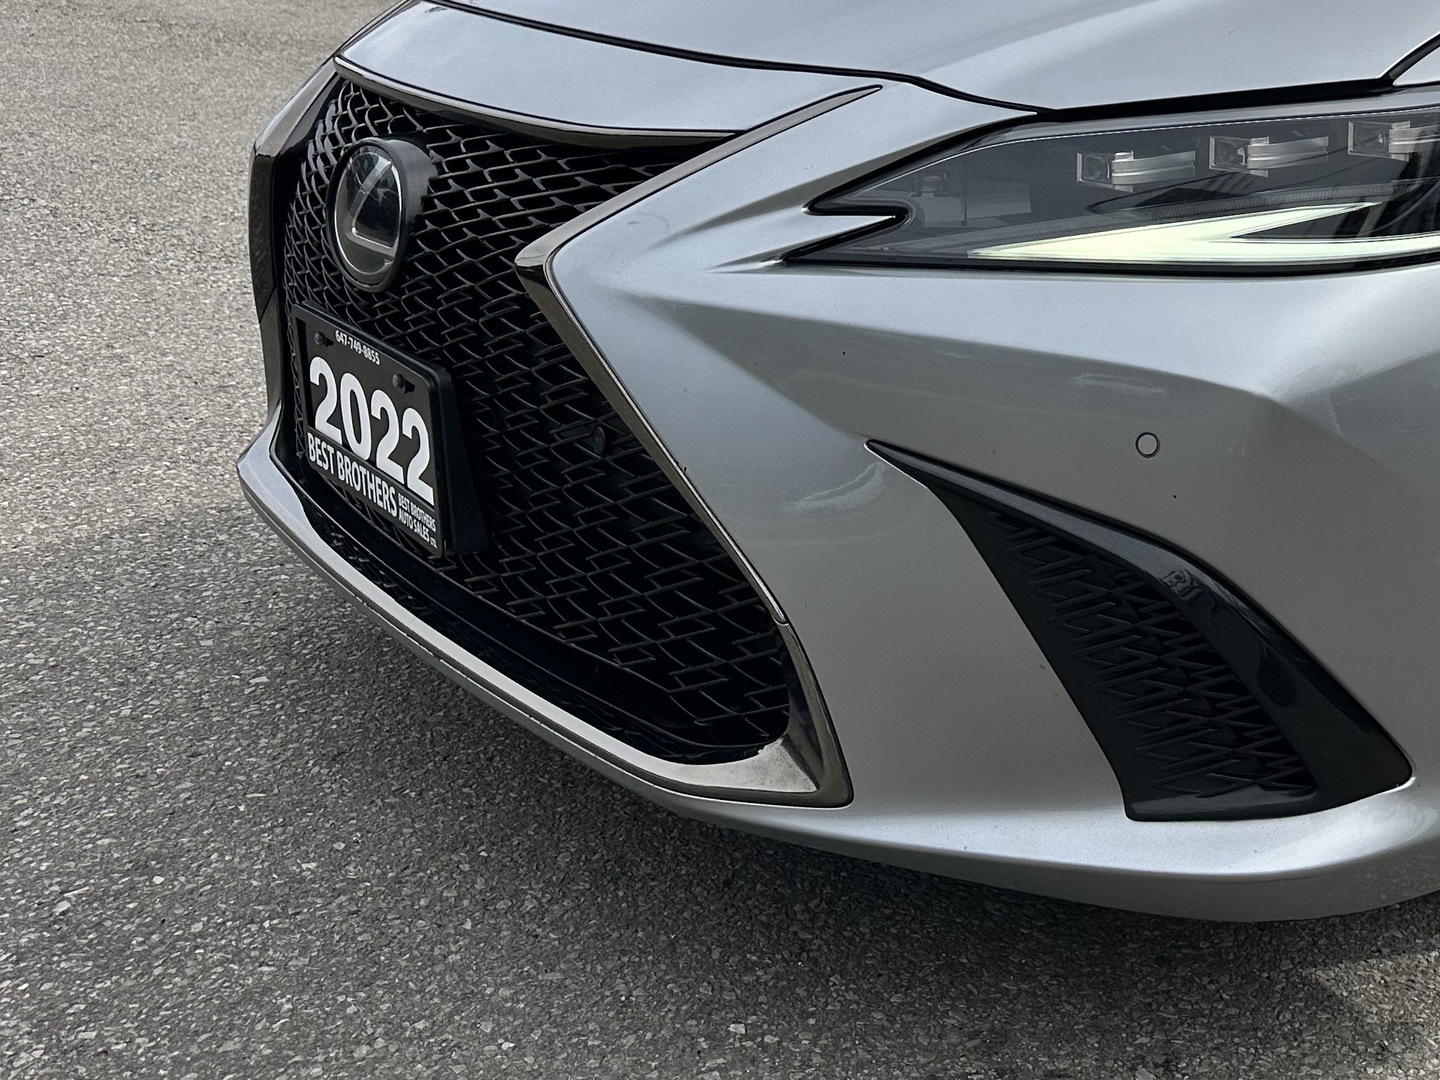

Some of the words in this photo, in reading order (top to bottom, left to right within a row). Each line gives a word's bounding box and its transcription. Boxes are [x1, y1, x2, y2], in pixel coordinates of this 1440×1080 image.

[335, 329, 381, 366] 647-749-8855
[309, 356, 435, 506] 2022
[307, 432, 335, 475] BEST
[336, 450, 398, 518] BROTHERS
[413, 518, 430, 543] SALES
